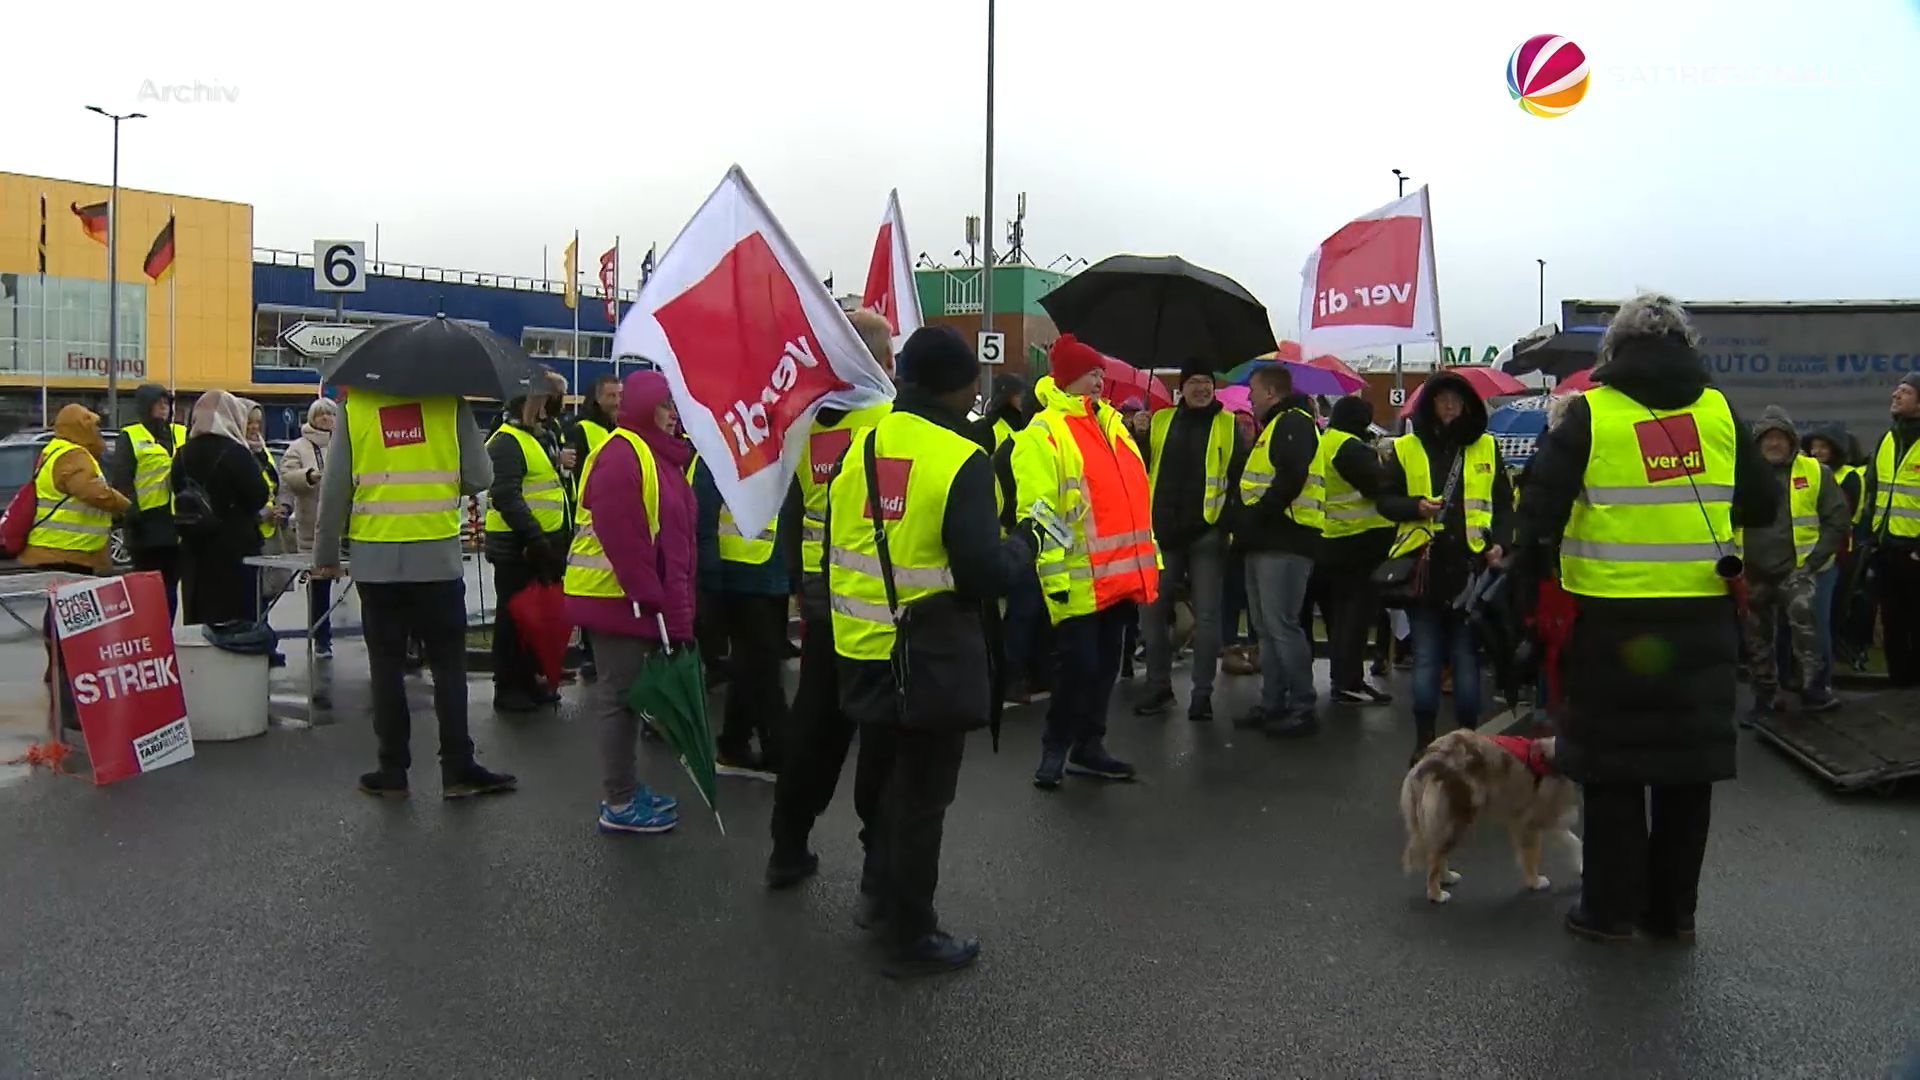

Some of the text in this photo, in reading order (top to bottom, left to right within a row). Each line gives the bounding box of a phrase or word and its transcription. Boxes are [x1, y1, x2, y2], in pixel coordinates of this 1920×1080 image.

[324, 244, 357, 287] 6
[983, 335, 1000, 360] 5
[1442, 345, 1500, 365] MA
[67, 352, 145, 378] Eingng
[1392, 390, 1402, 404] 3
[813, 463, 834, 474] ver
[99, 637, 153, 661] HEUTE
[74, 654, 179, 704] STREIK
